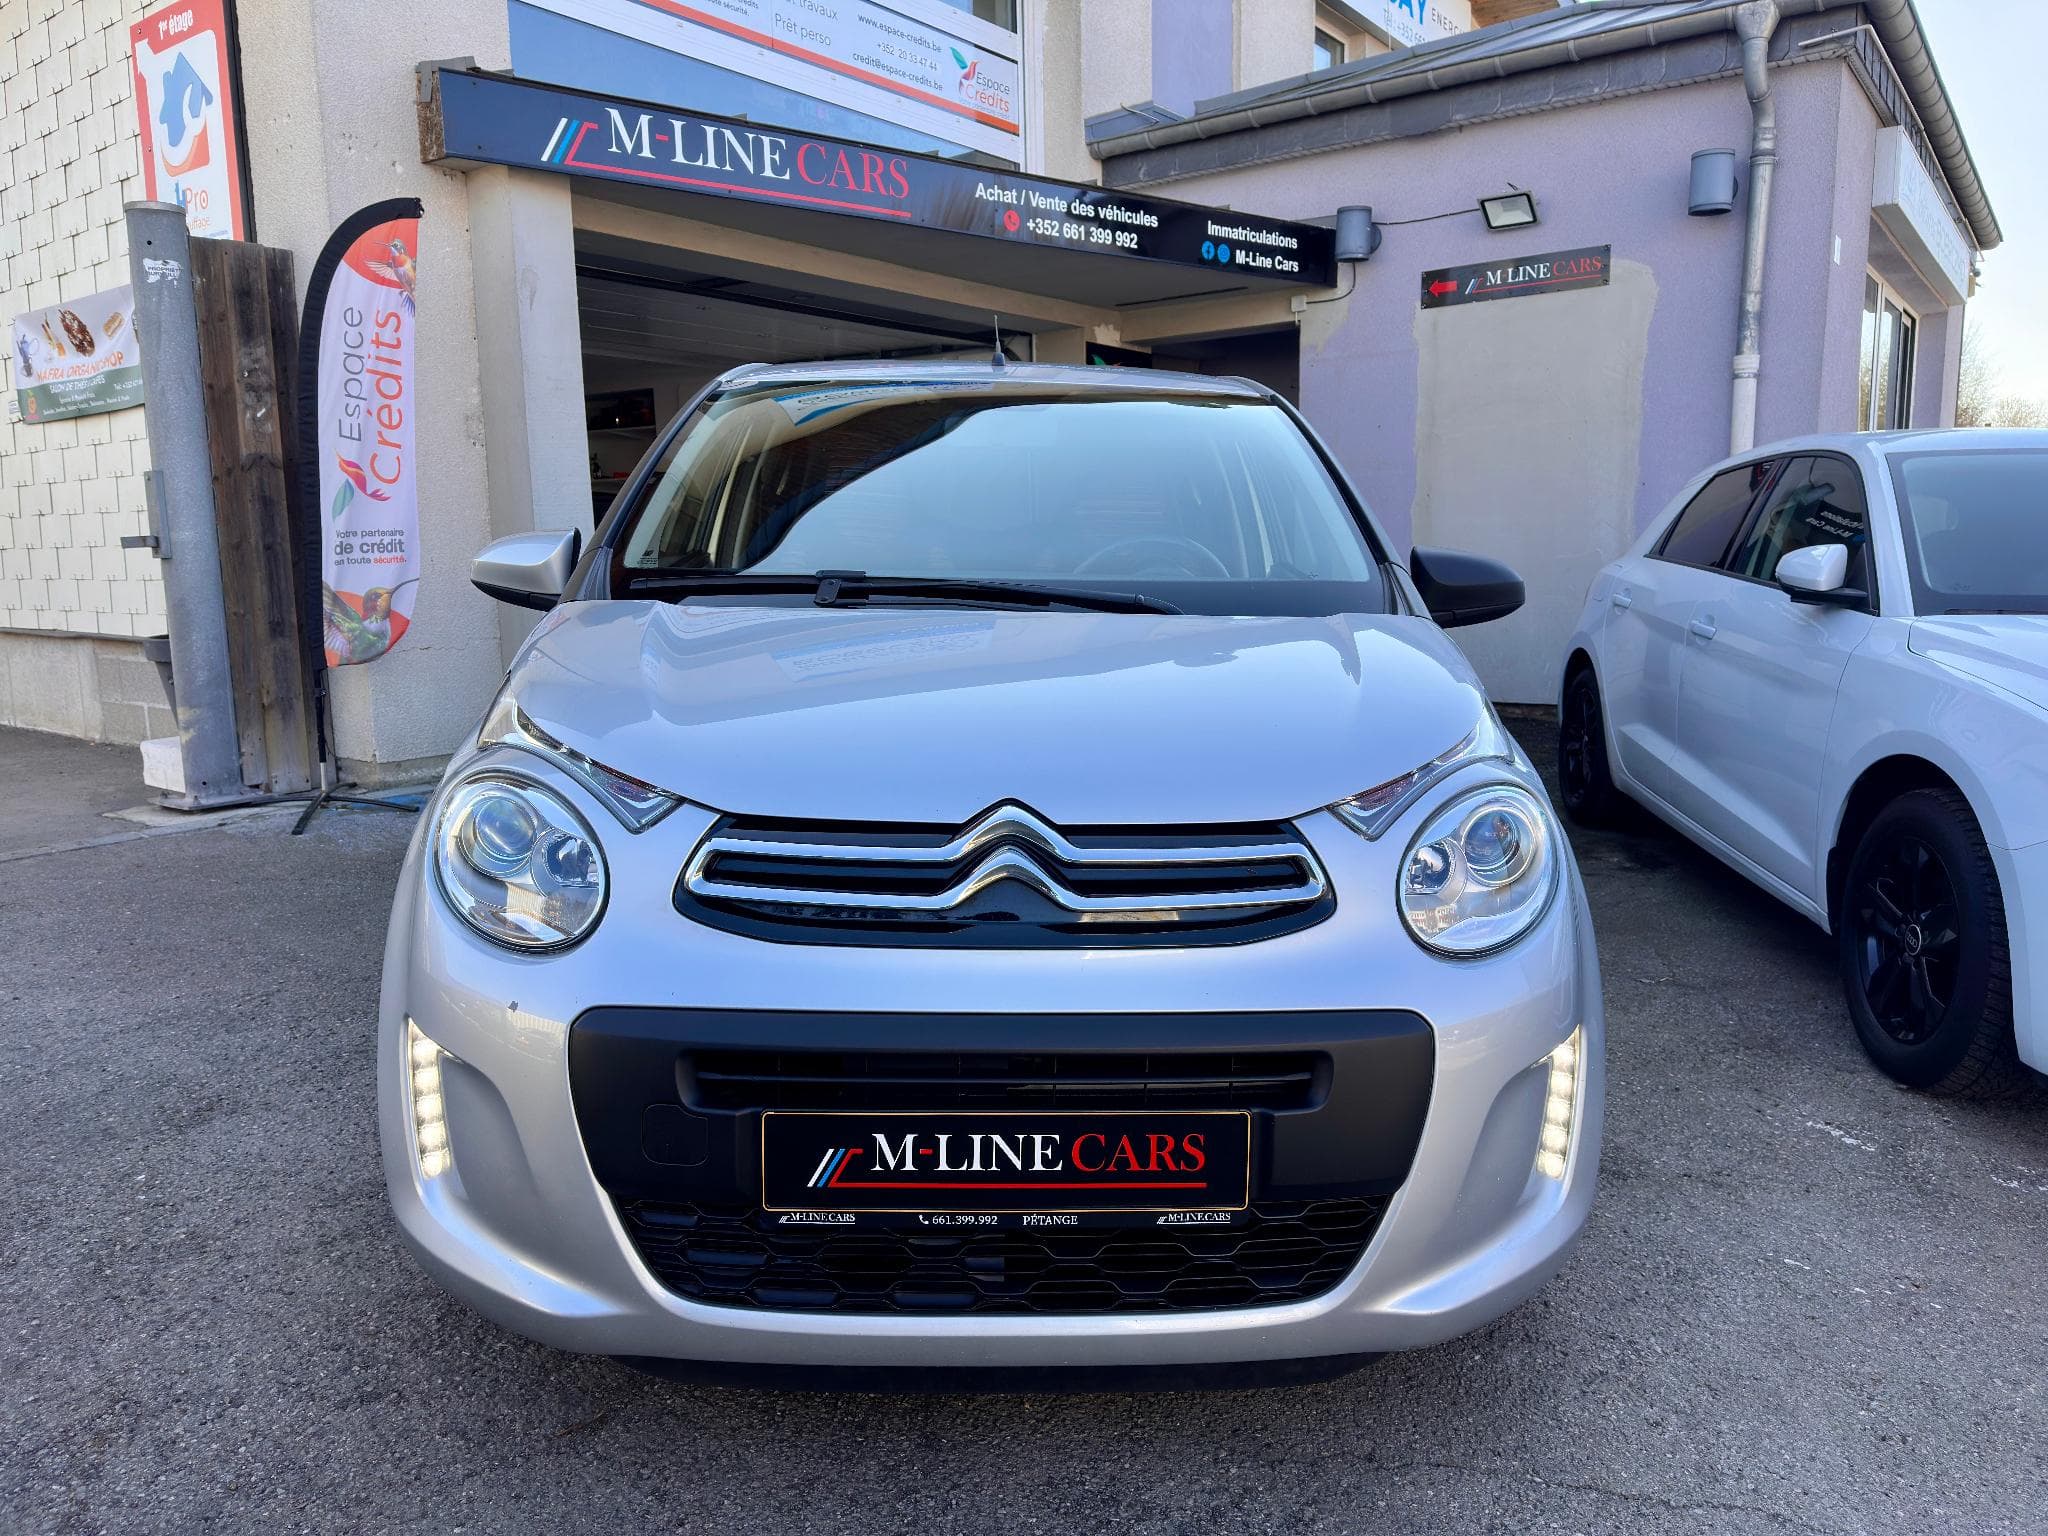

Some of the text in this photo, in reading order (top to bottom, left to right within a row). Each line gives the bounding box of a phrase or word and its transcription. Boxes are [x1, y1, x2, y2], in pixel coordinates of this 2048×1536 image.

[168, 9, 194, 36] étage
[775, 13, 832, 46] Prêt perso
[857, 13, 942, 53] www.espace-credits.be
[852, 52, 944, 92] credit@espace-credits.be
[976, 71, 1011, 96] Espace
[965, 84, 1010, 113] Crédits
[605, 107, 910, 200] M-LINE CARS
[975, 182, 1159, 228] Achat / Vente des véhicules
[1026, 219, 1138, 249] +352 661 399 992
[1207, 220, 1298, 249] Immatriculations
[1235, 249, 1299, 273] M-Line Cars
[1487, 256, 1602, 286] M-LINE CARS
[338, 306, 368, 442] Espace
[366, 310, 403, 485] Crédits
[334, 538, 405, 556] de crédit
[335, 528, 405, 539] Votre partenaire
[334, 558, 345, 566] en
[347, 556, 372, 565] toute
[871, 1132, 1206, 1173] M-LINE CARS
[790, 1212, 856, 1222] M-LINE CARS
[932, 1215, 998, 1225] 661.399.992
[1023, 1213, 1079, 1226] PÉTANGE
[1168, 1212, 1231, 1222] M-LINE CARS
